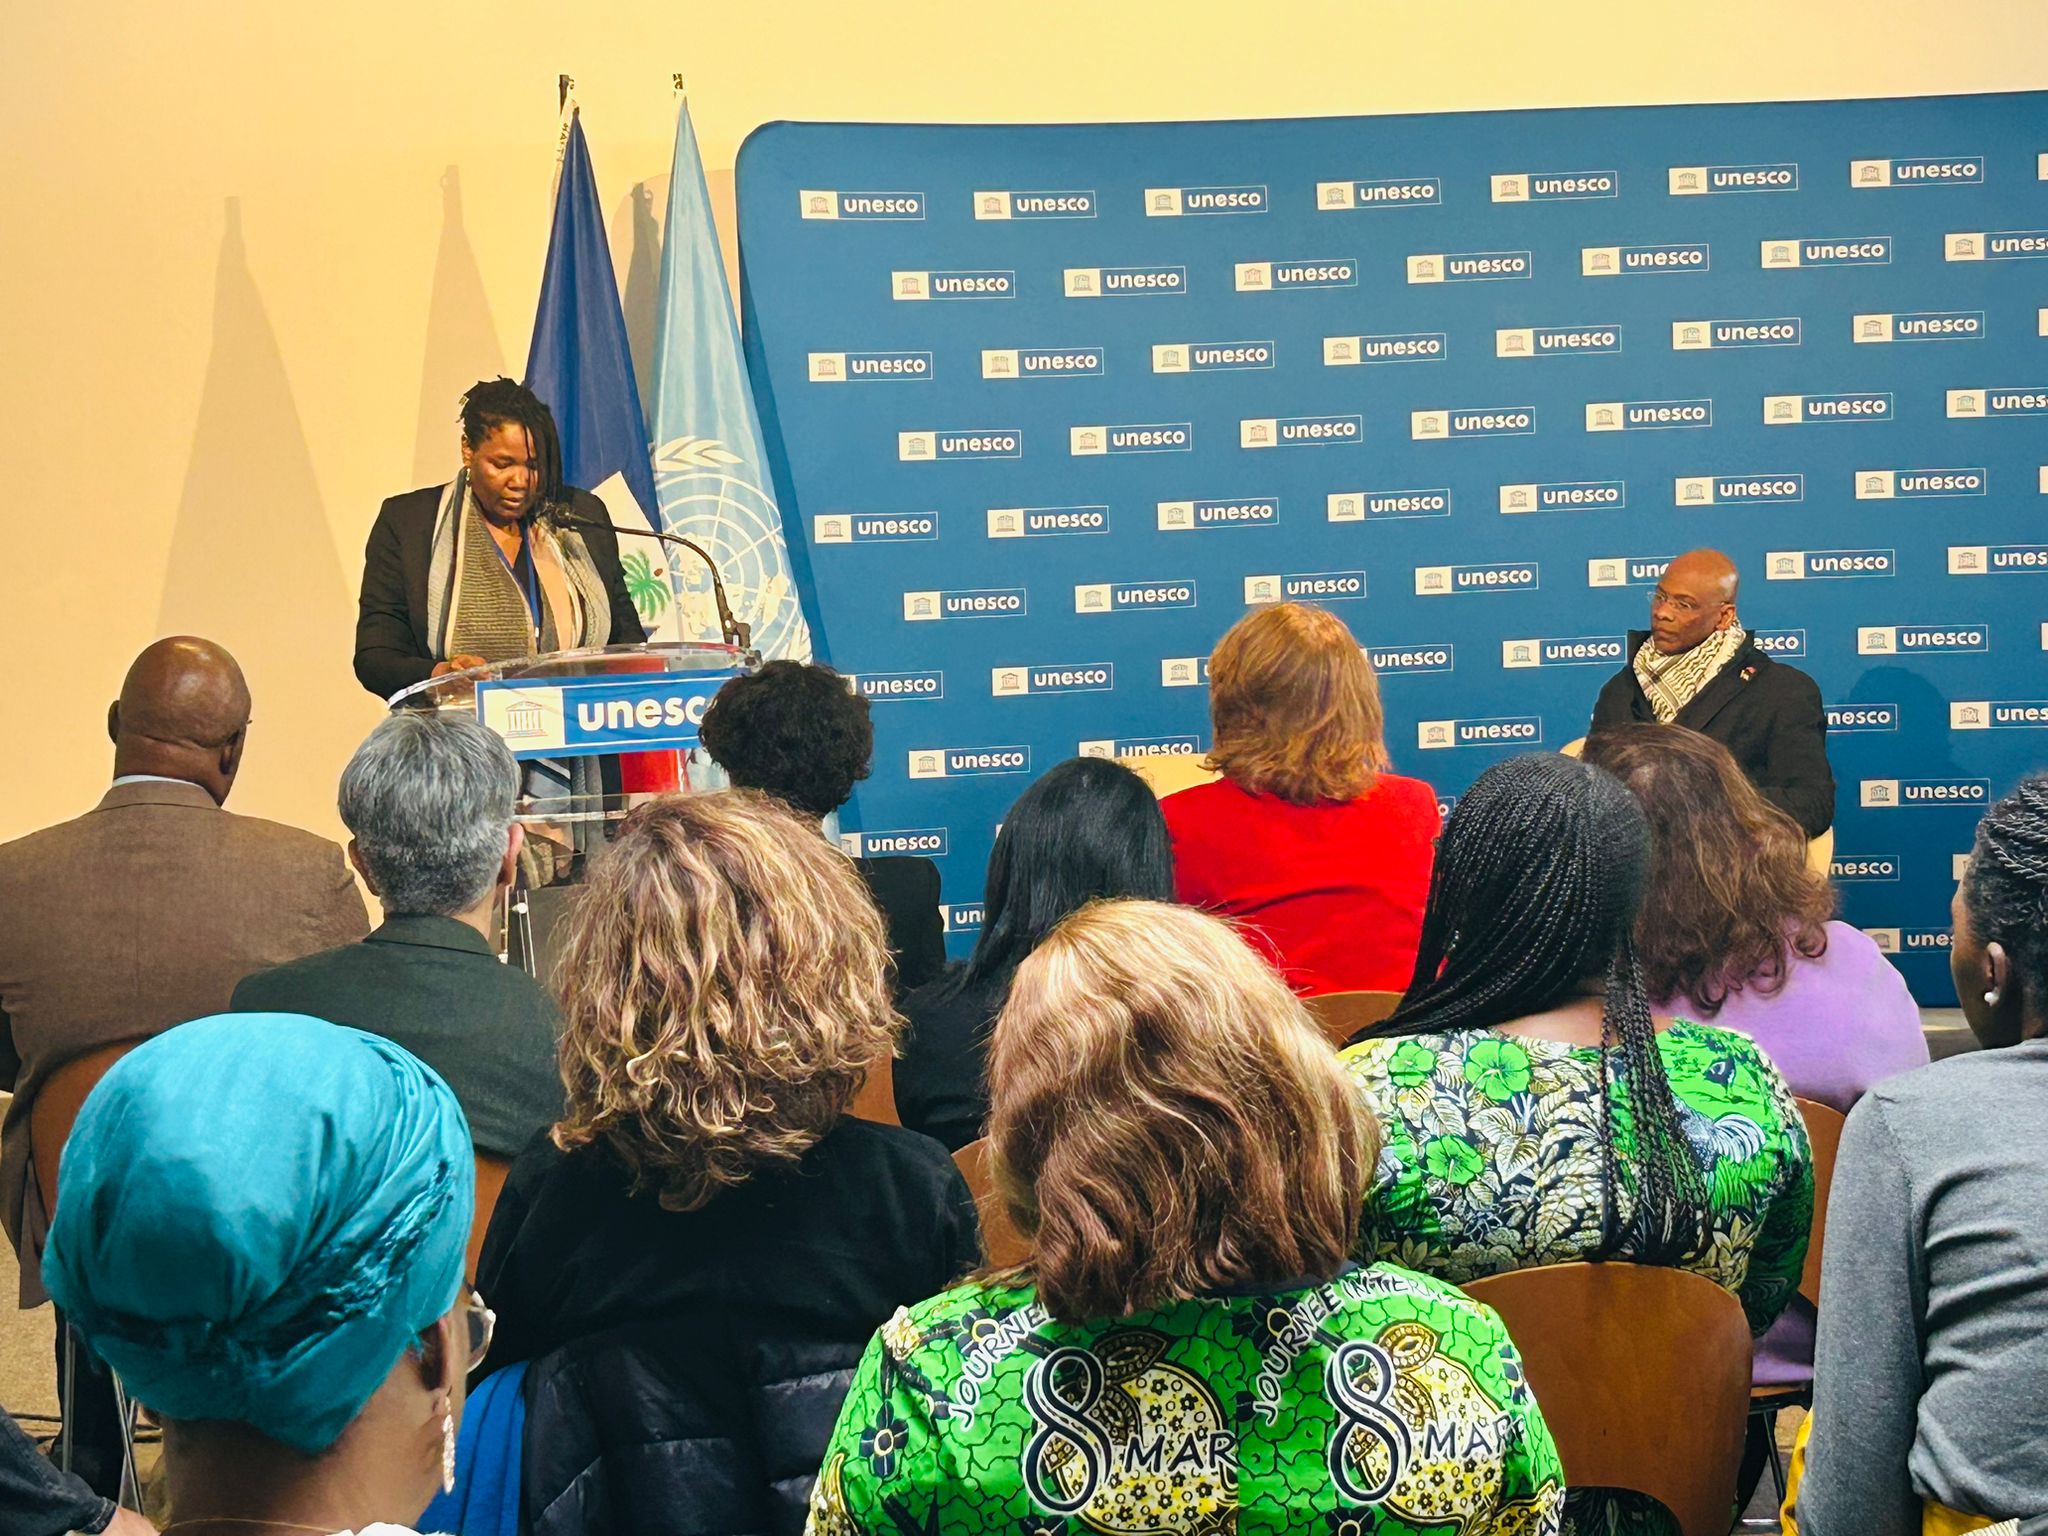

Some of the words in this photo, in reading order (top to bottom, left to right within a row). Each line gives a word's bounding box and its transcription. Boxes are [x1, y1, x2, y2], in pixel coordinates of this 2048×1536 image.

[1713, 170, 1792, 187] unesco
[1897, 163, 1977, 179] unesco
[1360, 184, 1435, 201] unesco
[1534, 177, 1612, 194] unesco
[843, 198, 919, 214] unesco
[1016, 197, 1090, 213] unesco
[1187, 192, 1261, 208] unesco
[1806, 243, 1885, 260] unesco
[1991, 237, 2048, 253] unes
[1449, 257, 1526, 275] unesco
[1625, 250, 1703, 267] unesco
[1106, 272, 1180, 289] unesco
[1277, 266, 1352, 283] unesco
[934, 277, 1010, 293] unesco
[1717, 324, 1795, 342] unesco
[1898, 318, 1979, 334] unesco
[1365, 339, 1441, 357] unesco
[1539, 332, 1616, 349] unesco
[1024, 354, 1098, 371] unesco
[1194, 347, 1269, 365] unesco
[851, 358, 927, 374] unesco
[1808, 399, 1887, 416] unesco
[1992, 394, 2048, 410] unes
[1454, 413, 1530, 431] unesco
[1629, 406, 1706, 423] unesco
[1112, 430, 1186, 447] unesco
[1282, 422, 1357, 439] unesco
[941, 436, 1016, 453] unesco
[1719, 481, 1797, 497] unesco
[1900, 475, 1980, 491] unesco
[1370, 496, 1445, 513] unesco
[1543, 488, 1619, 505] unesco
[1029, 512, 1103, 530] unesco
[1199, 504, 1273, 522] unesco
[857, 519, 932, 535] unesco
[1810, 556, 1889, 572] unesco
[1993, 551, 2048, 567] unes
[1457, 569, 1533, 586] unesco
[1286, 578, 1360, 595] unesco
[946, 595, 1020, 612] unesco
[1117, 587, 1190, 604] unesco
[1753, 636, 1800, 651] esco
[1902, 631, 1982, 647] unesco
[1546, 642, 1622, 659] unesco
[1373, 651, 1448, 668] unesco
[862, 678, 937, 695] unesco
[1034, 669, 1107, 687] unesco
[577, 695, 706, 732] unesc
[1827, 711, 1891, 726] nesco
[1996, 707, 2048, 722] unes
[1460, 723, 1536, 740] unesco
[1120, 742, 1193, 756] unesco
[951, 752, 1024, 770] unesco
[1905, 785, 1984, 799] unesco
[867, 835, 941, 852] unesco
[1831, 860, 1893, 875] nesco
[1907, 932, 1953, 947] une
[1253, 1284, 1343, 1427] JOURNEE
[950, 1302, 1054, 1430] JOURNE
[1023, 1346, 1113, 1514] 8
[1124, 1430, 1238, 1472] MAR
[1325, 1340, 1412, 1504] 8
